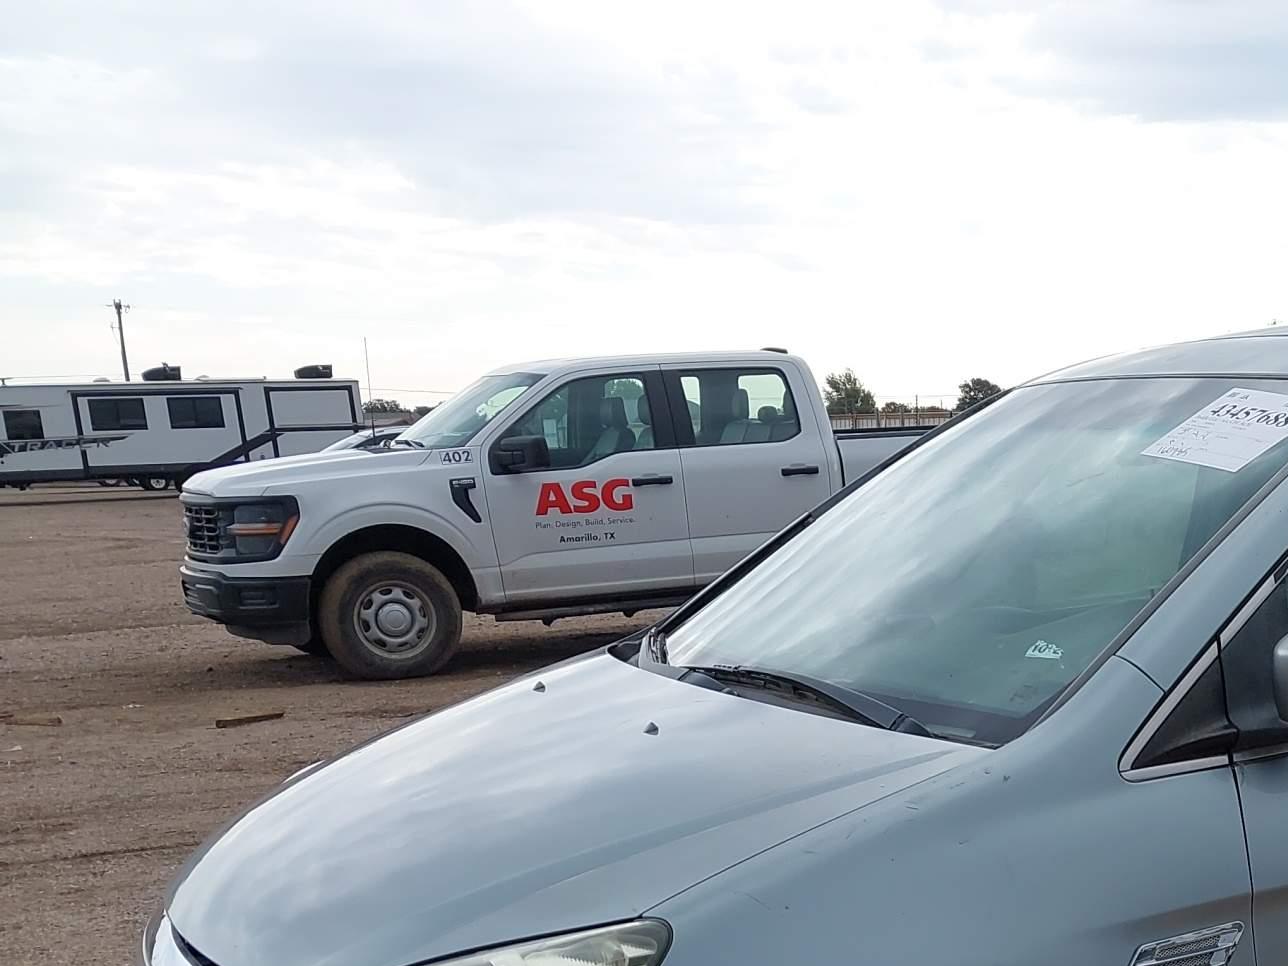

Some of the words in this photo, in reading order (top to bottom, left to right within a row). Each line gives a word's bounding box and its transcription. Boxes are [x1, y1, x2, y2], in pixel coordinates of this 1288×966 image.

[442, 450, 473, 464] 402
[535, 478, 634, 516] ASG
[559, 533, 601, 544] Amarillo,
[604, 532, 616, 541] TX
